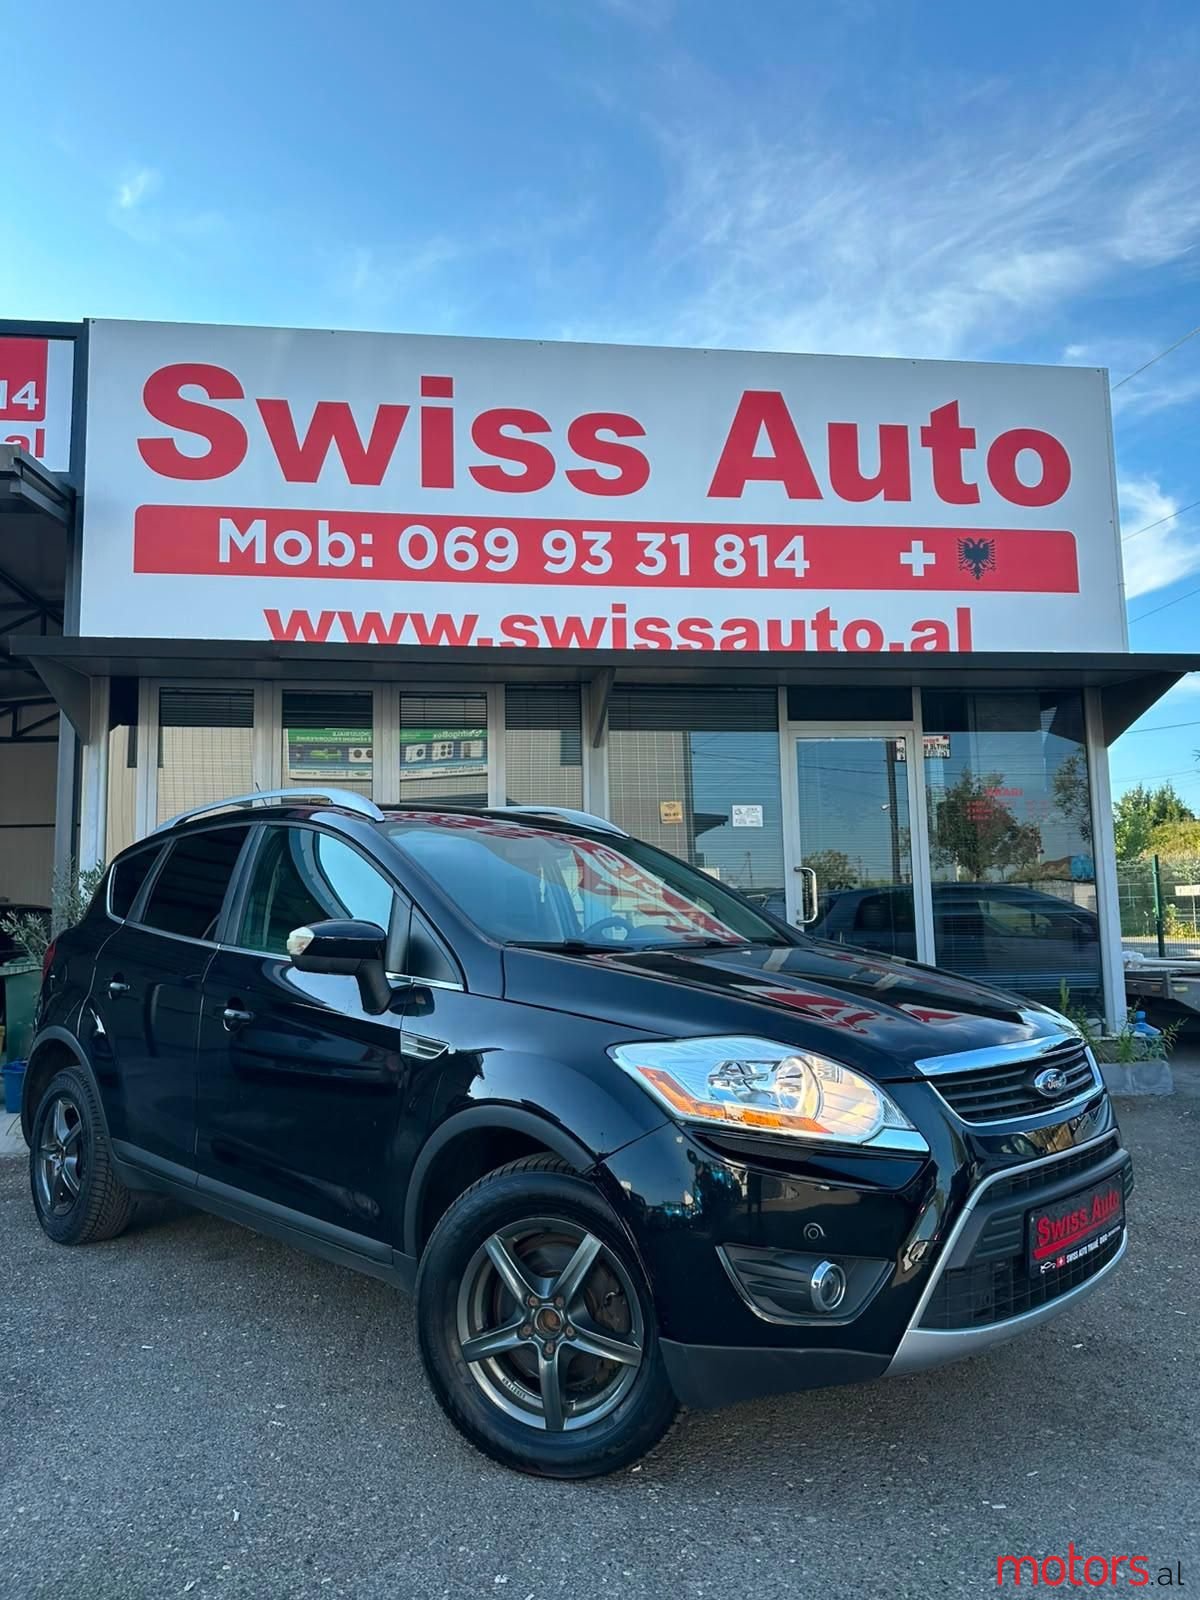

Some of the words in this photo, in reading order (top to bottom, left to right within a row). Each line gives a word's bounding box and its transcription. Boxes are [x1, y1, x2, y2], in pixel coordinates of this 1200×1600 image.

[138, 363, 650, 496] Swiss
[708, 389, 1072, 508] Auto
[217, 517, 375, 570] Mob:
[397, 523, 520, 573] 069
[540, 528, 614, 576] 93
[634, 531, 691, 578] 31
[712, 533, 811, 579] 814
[264, 604, 974, 653] www.swissauto.al
